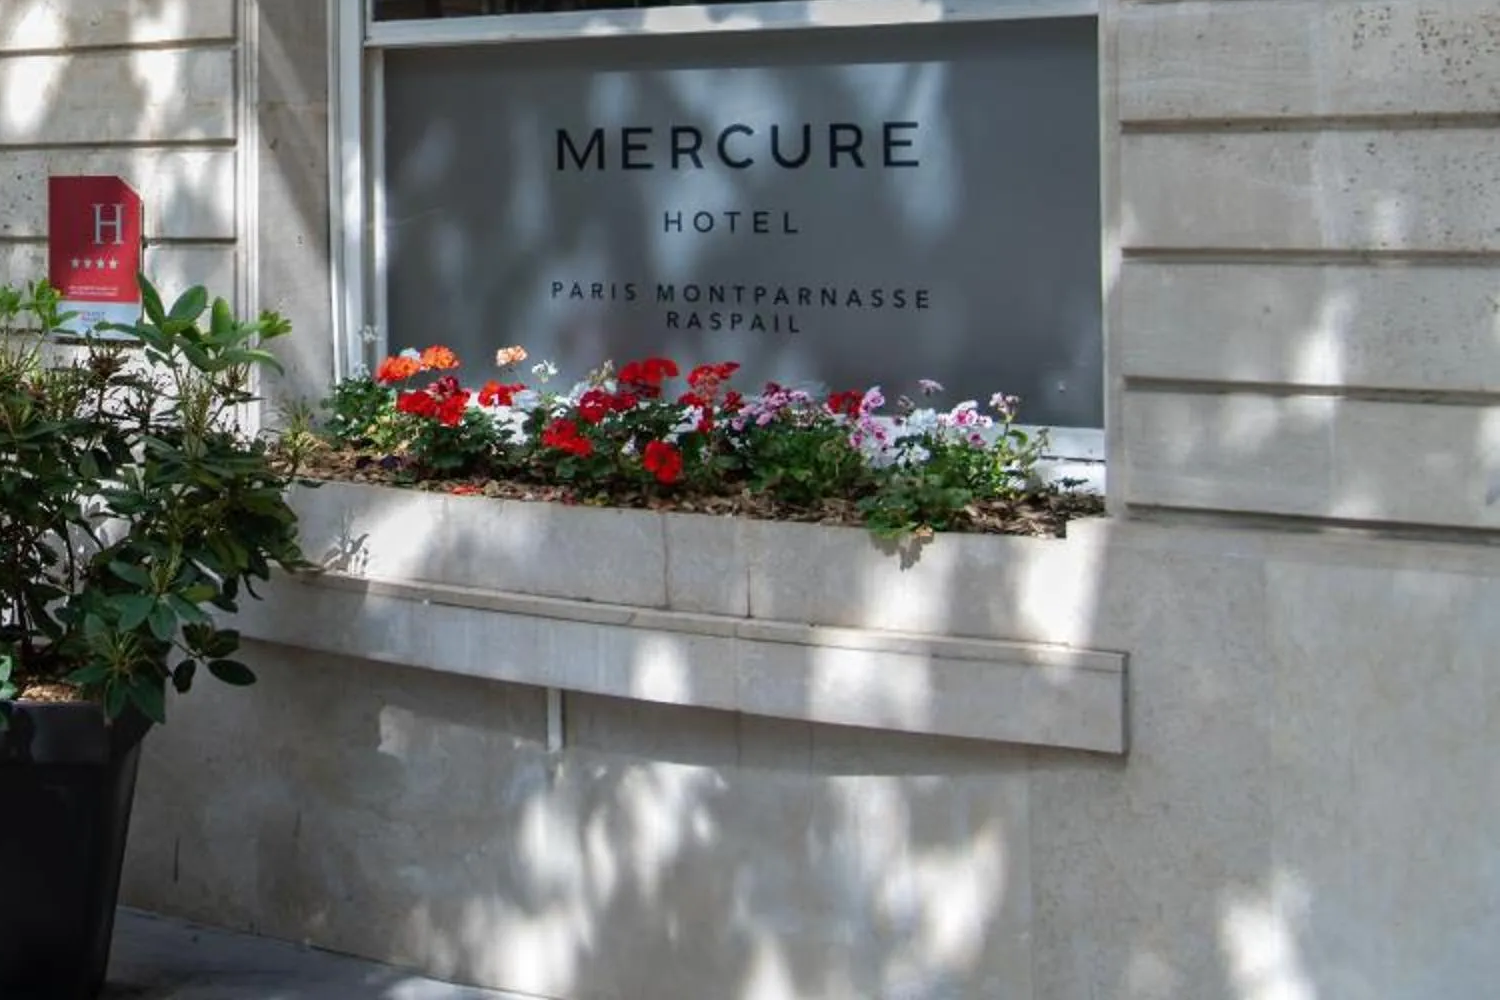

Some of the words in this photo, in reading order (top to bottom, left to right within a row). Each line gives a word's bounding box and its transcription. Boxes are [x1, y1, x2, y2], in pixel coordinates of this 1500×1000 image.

[556, 121, 919, 170] MERCURE
[91, 203, 126, 245] H
[664, 211, 800, 234] HOTEL
[551, 281, 636, 300] PARIS
[657, 285, 929, 309] MONTPARNASSE
[667, 311, 800, 333] RASPAIL
